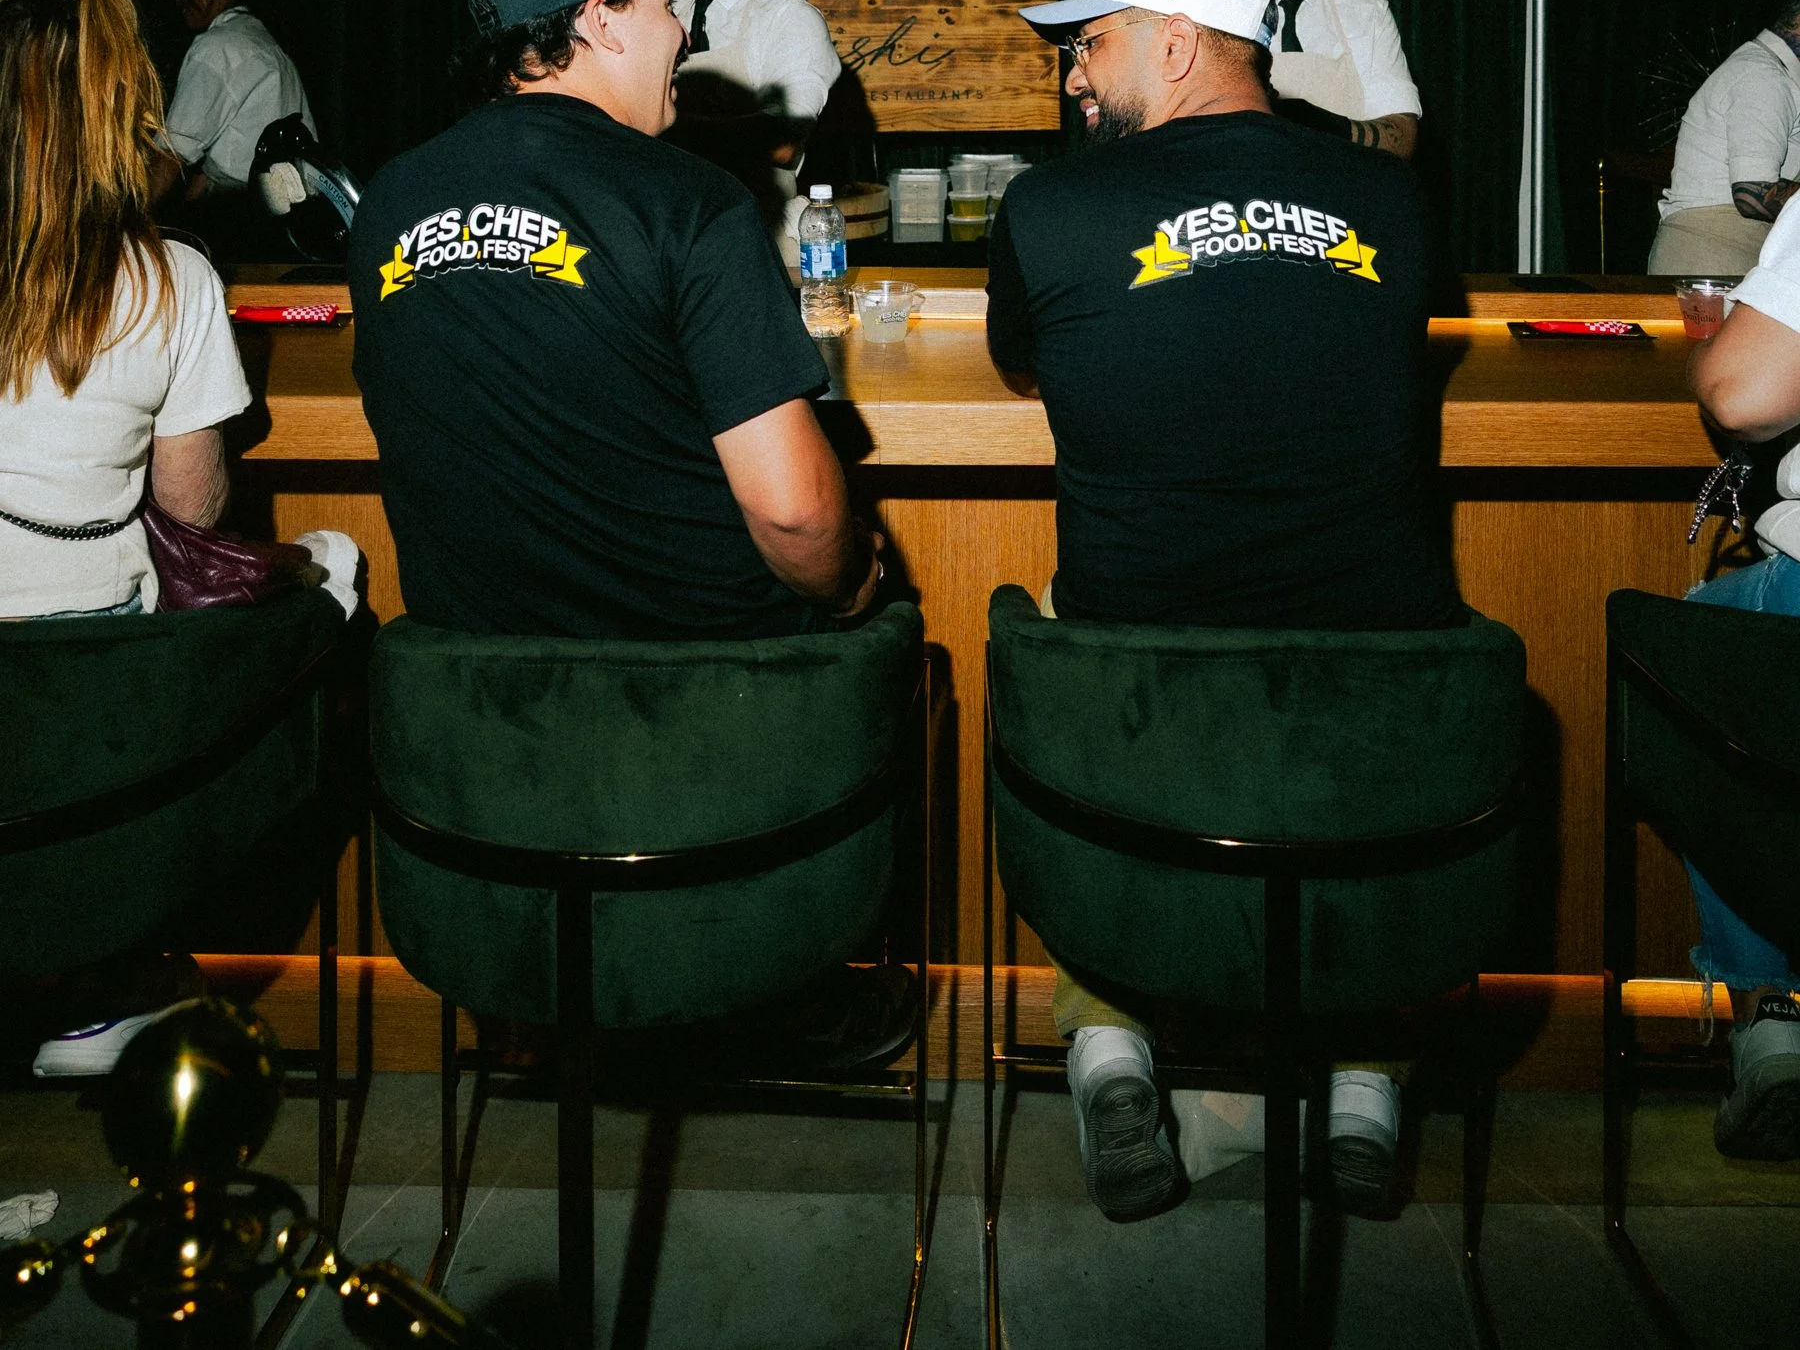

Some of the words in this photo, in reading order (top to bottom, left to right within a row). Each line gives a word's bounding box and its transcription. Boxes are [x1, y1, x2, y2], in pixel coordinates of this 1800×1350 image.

[866, 89, 984, 101] ESTAURANTS
[319, 175, 349, 208] CAUTION
[399, 210, 461, 259] YES
[469, 206, 561, 247] CHEF
[1158, 203, 1236, 246] YES
[1245, 201, 1348, 244] CHEF
[414, 239, 478, 272] FOOD
[483, 239, 535, 264] FEST
[1191, 233, 1262, 261] FOOD
[1268, 232, 1328, 260] FEST
[1761, 1002, 1797, 1017] VEJA
